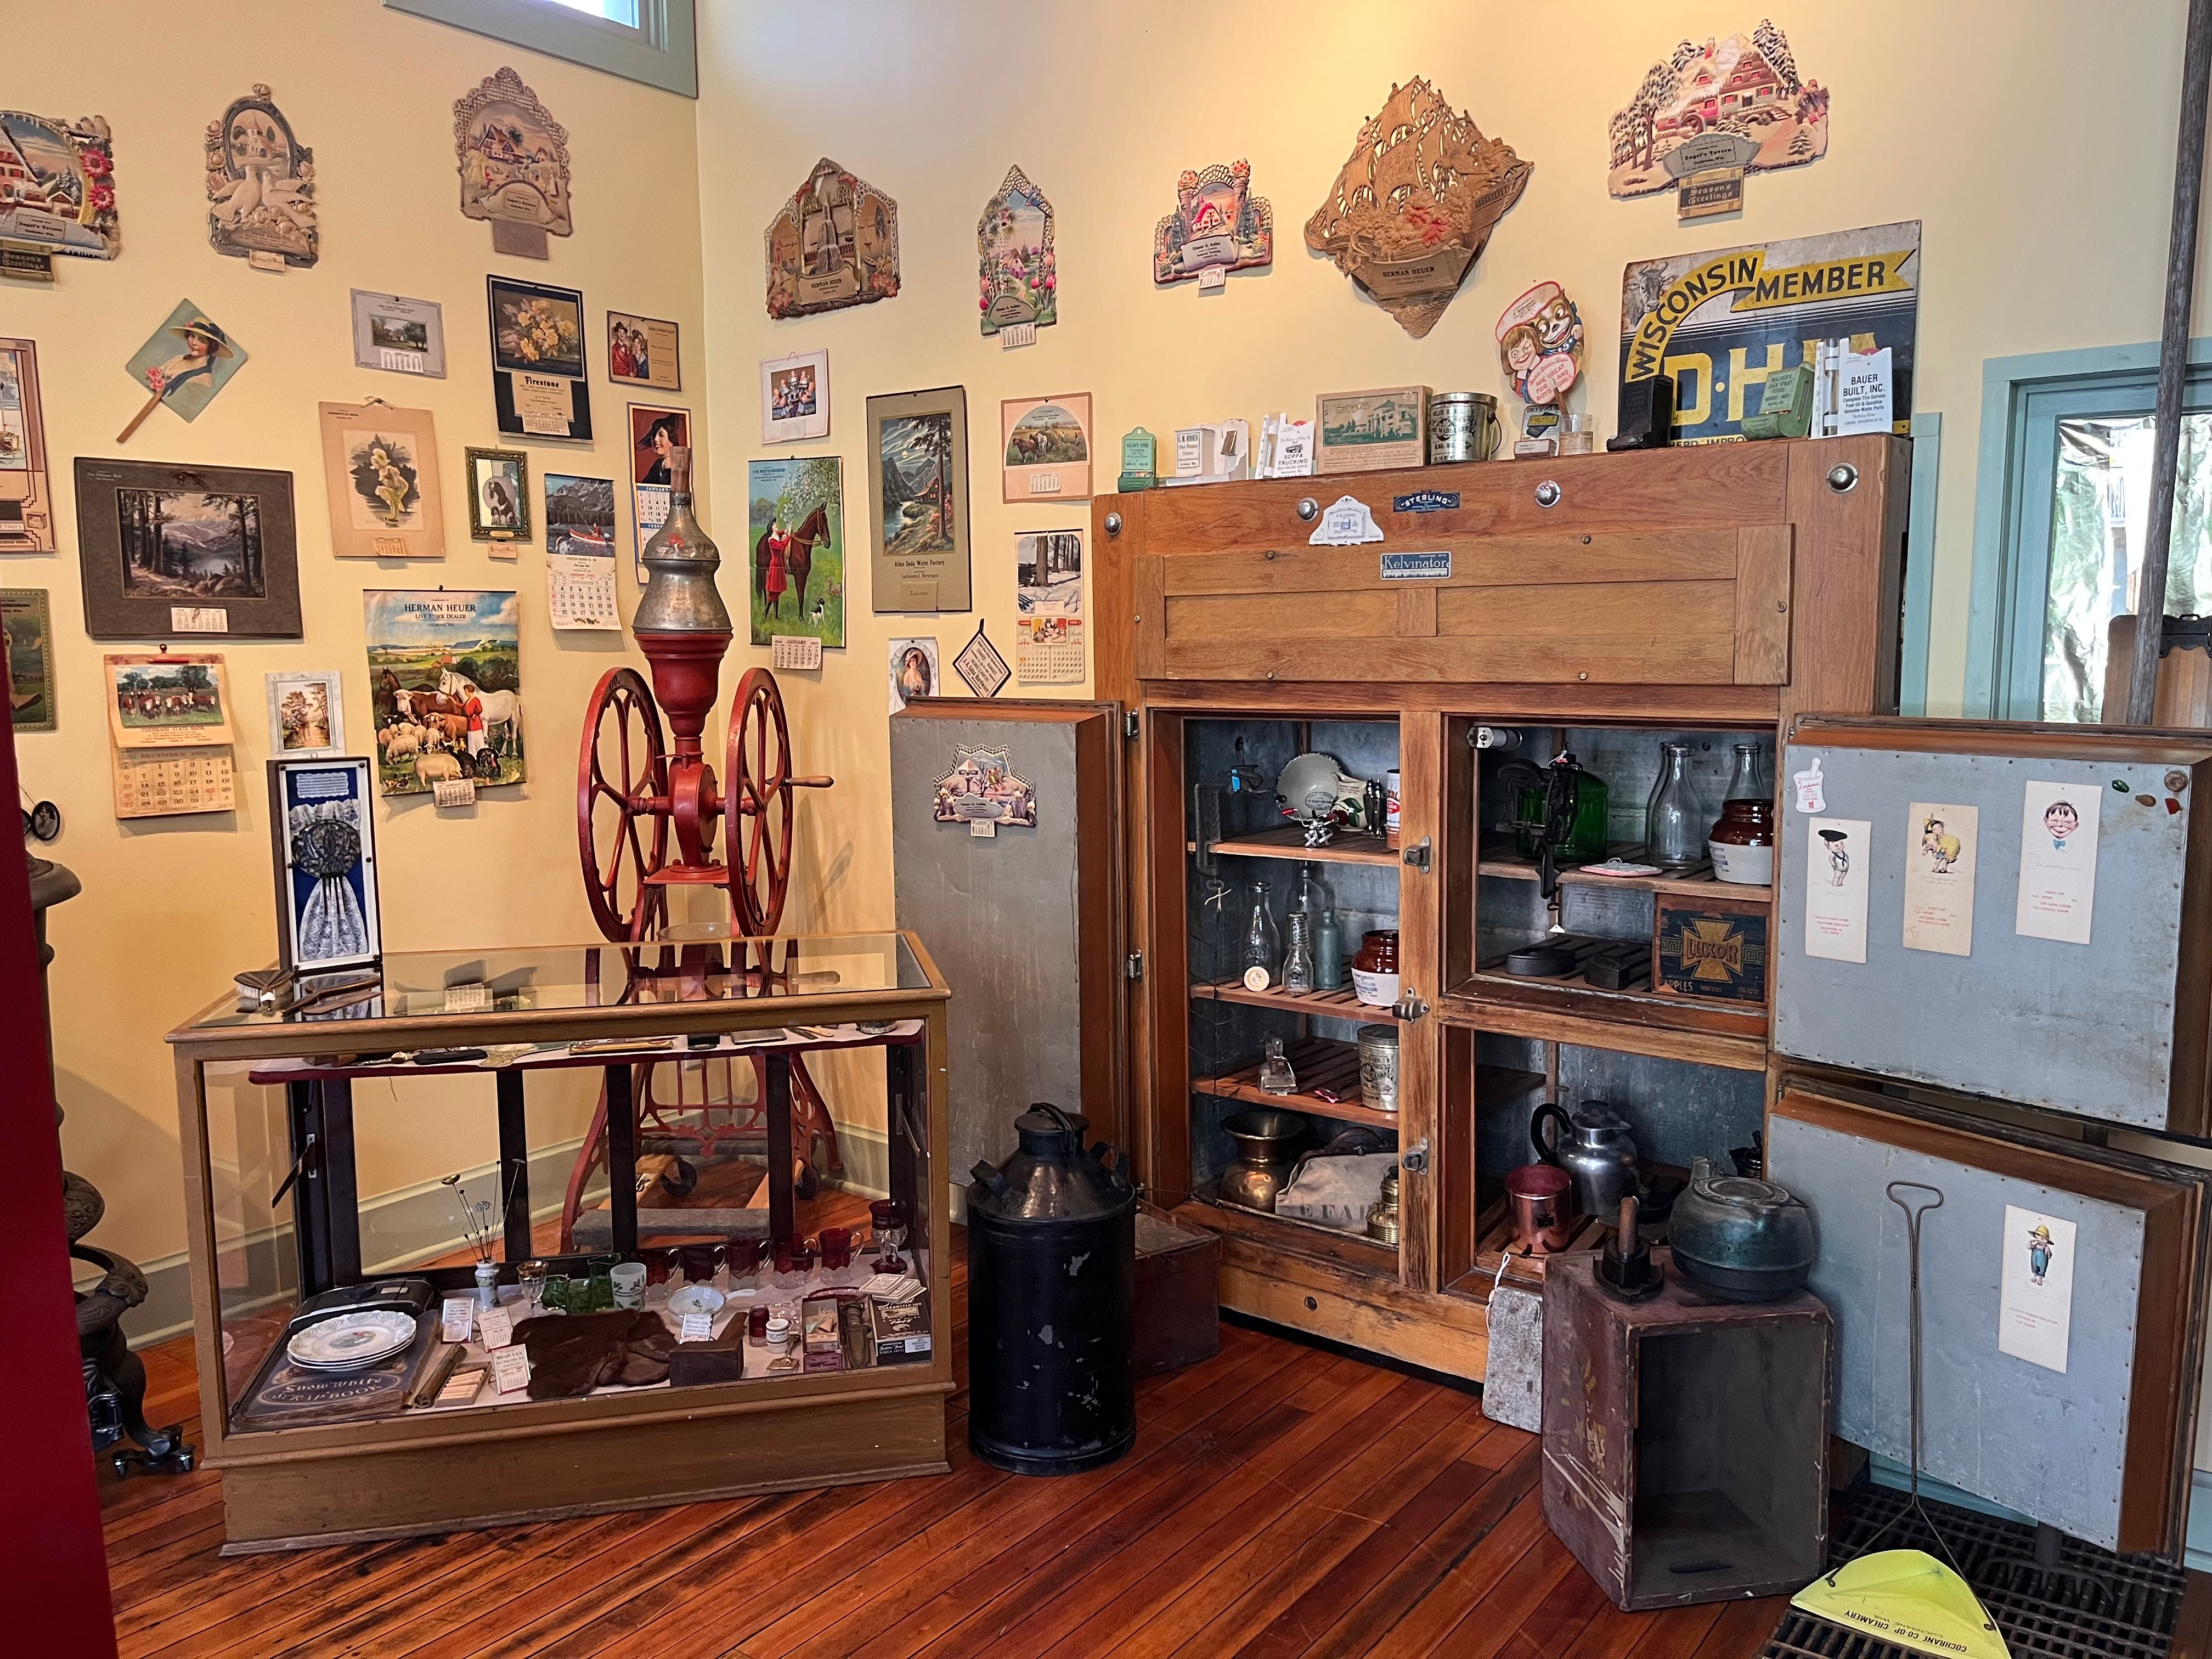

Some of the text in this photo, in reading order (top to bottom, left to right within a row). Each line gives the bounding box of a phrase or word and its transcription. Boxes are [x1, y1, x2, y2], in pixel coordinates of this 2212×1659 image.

[1690, 183, 1731, 195] Season's
[1689, 191, 1733, 204] Greetings
[1632, 257, 1884, 380] WISCONSIN MEMBER
[1536, 364, 1564, 387] ARE GREAT
[1557, 374, 1572, 387] GIRLS
[1558, 369, 1568, 379] AND
[1852, 374, 1877, 385] BAUER
[524, 376, 559, 387] Firestone
[1537, 384, 1548, 393] FOR
[1843, 383, 1885, 396] BUILT, INC.
[1536, 389, 1551, 402] BOYS
[1384, 555, 1446, 569] Kelvinator
[975, 674, 989, 692] Hardware
[1687, 939, 1737, 964] LUXOR
[285, 1378, 382, 1393] Snow White
[272, 1385, 383, 1401] SCRAP BOOK
[1844, 1610, 1888, 1629] CREAMERY
[1922, 1636, 1967, 1652] COCHRANE
